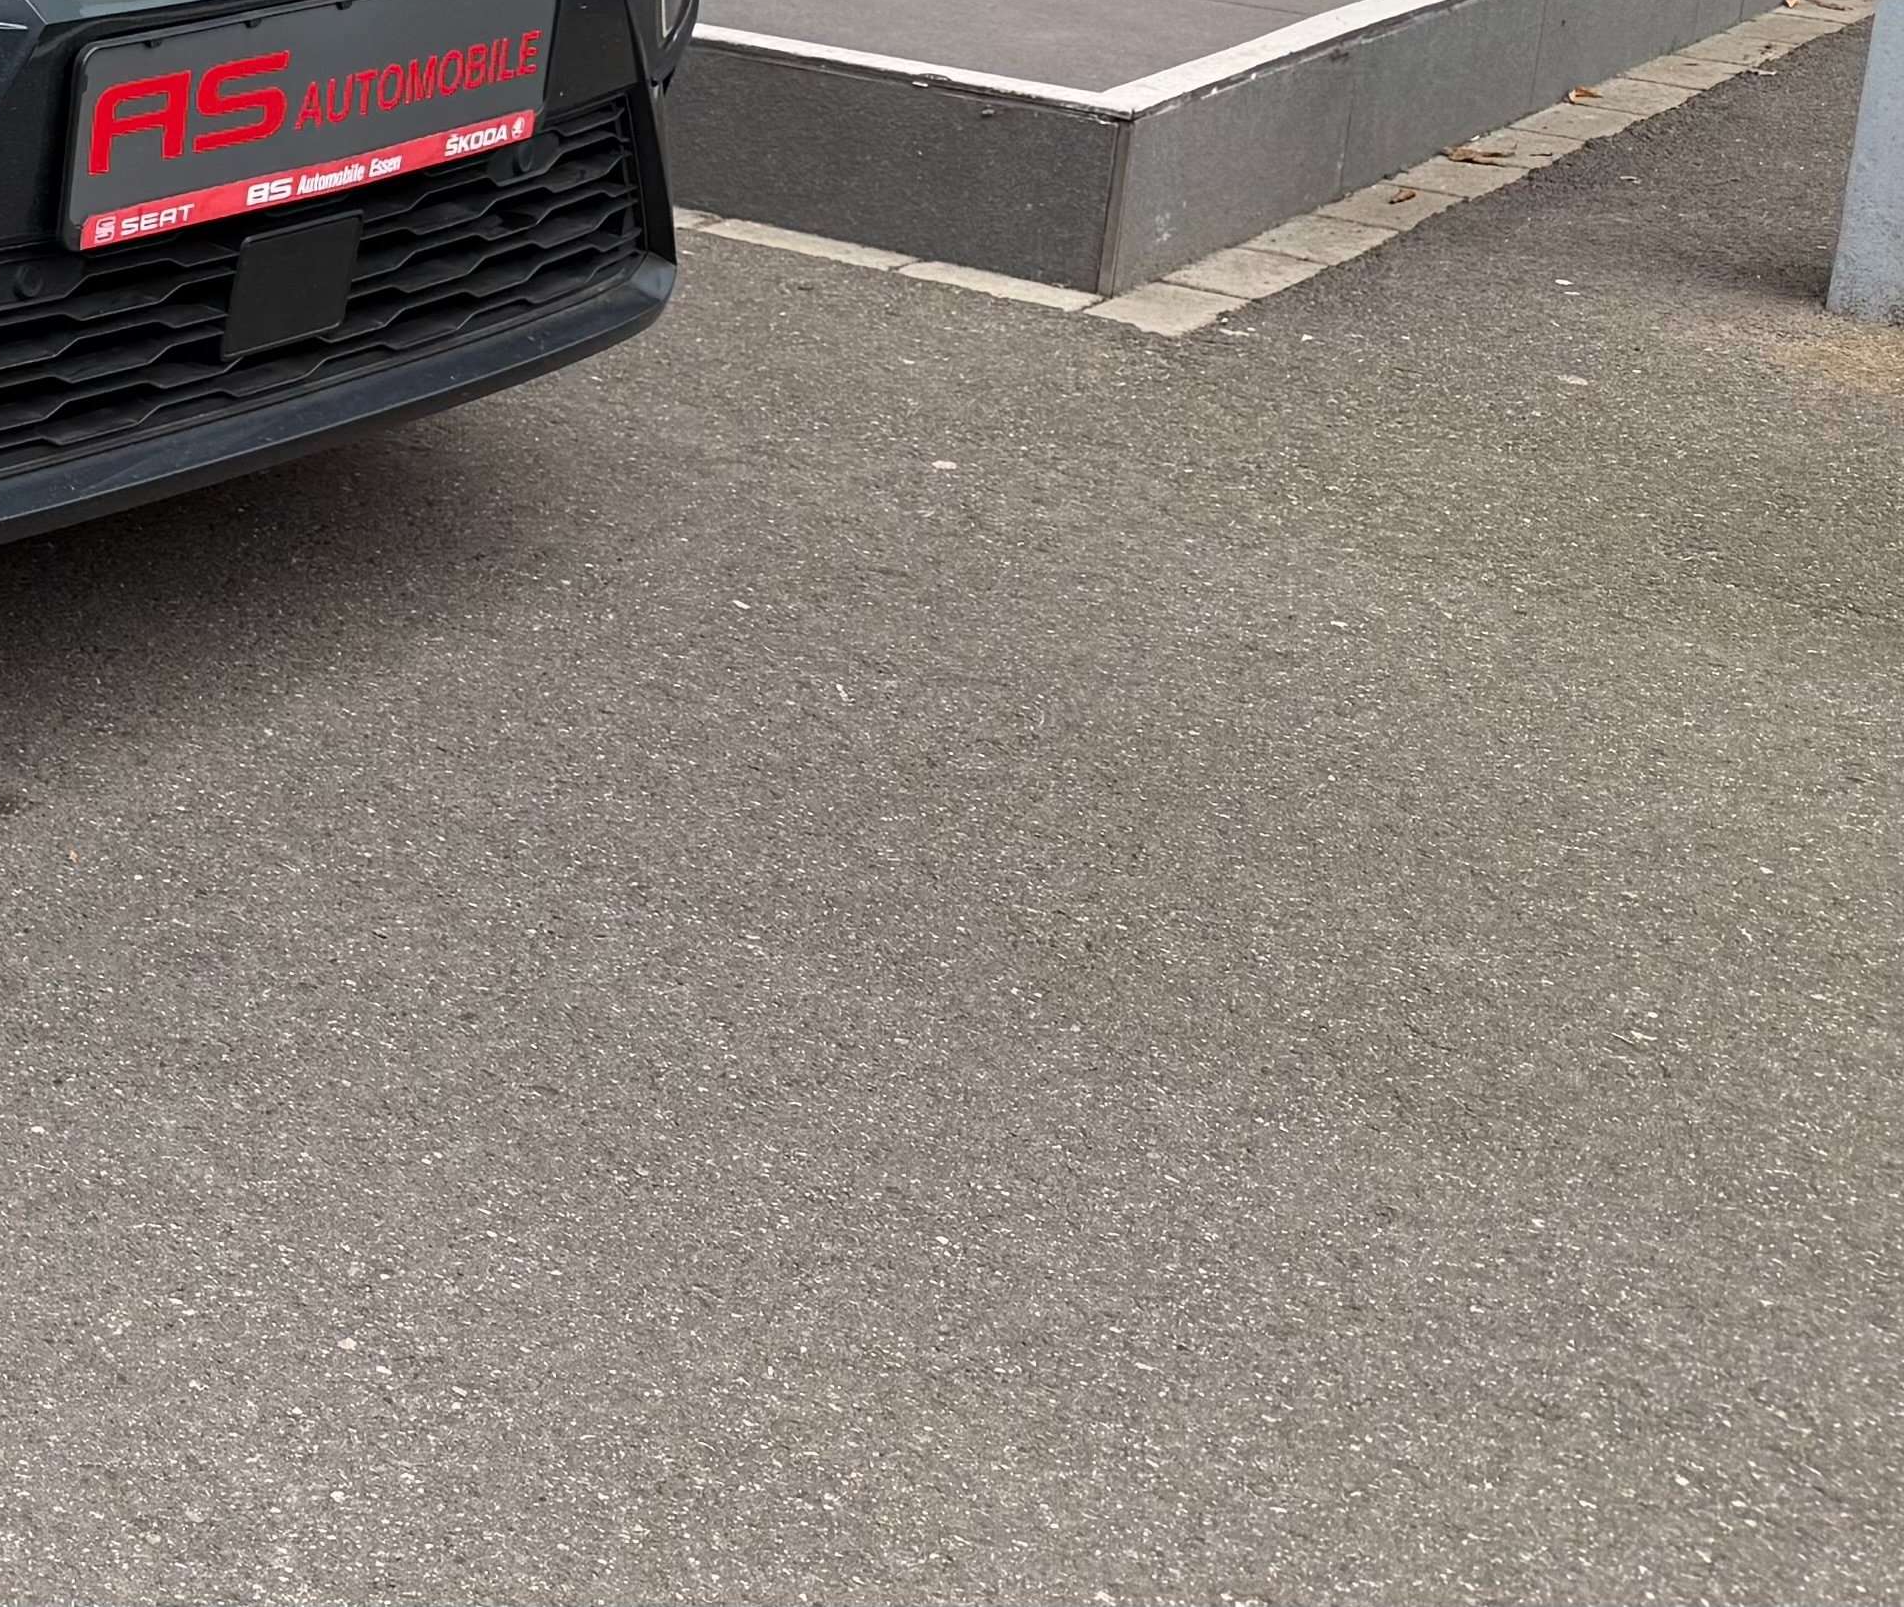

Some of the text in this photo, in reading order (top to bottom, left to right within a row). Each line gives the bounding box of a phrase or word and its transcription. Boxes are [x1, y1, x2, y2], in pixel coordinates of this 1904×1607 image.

[88, 29, 542, 176] AS AUTOMOBILE
[443, 124, 510, 158] ŠKODA
[296, 163, 366, 196] Automobile
[367, 154, 404, 179] Essen
[119, 202, 195, 237] SEAT
